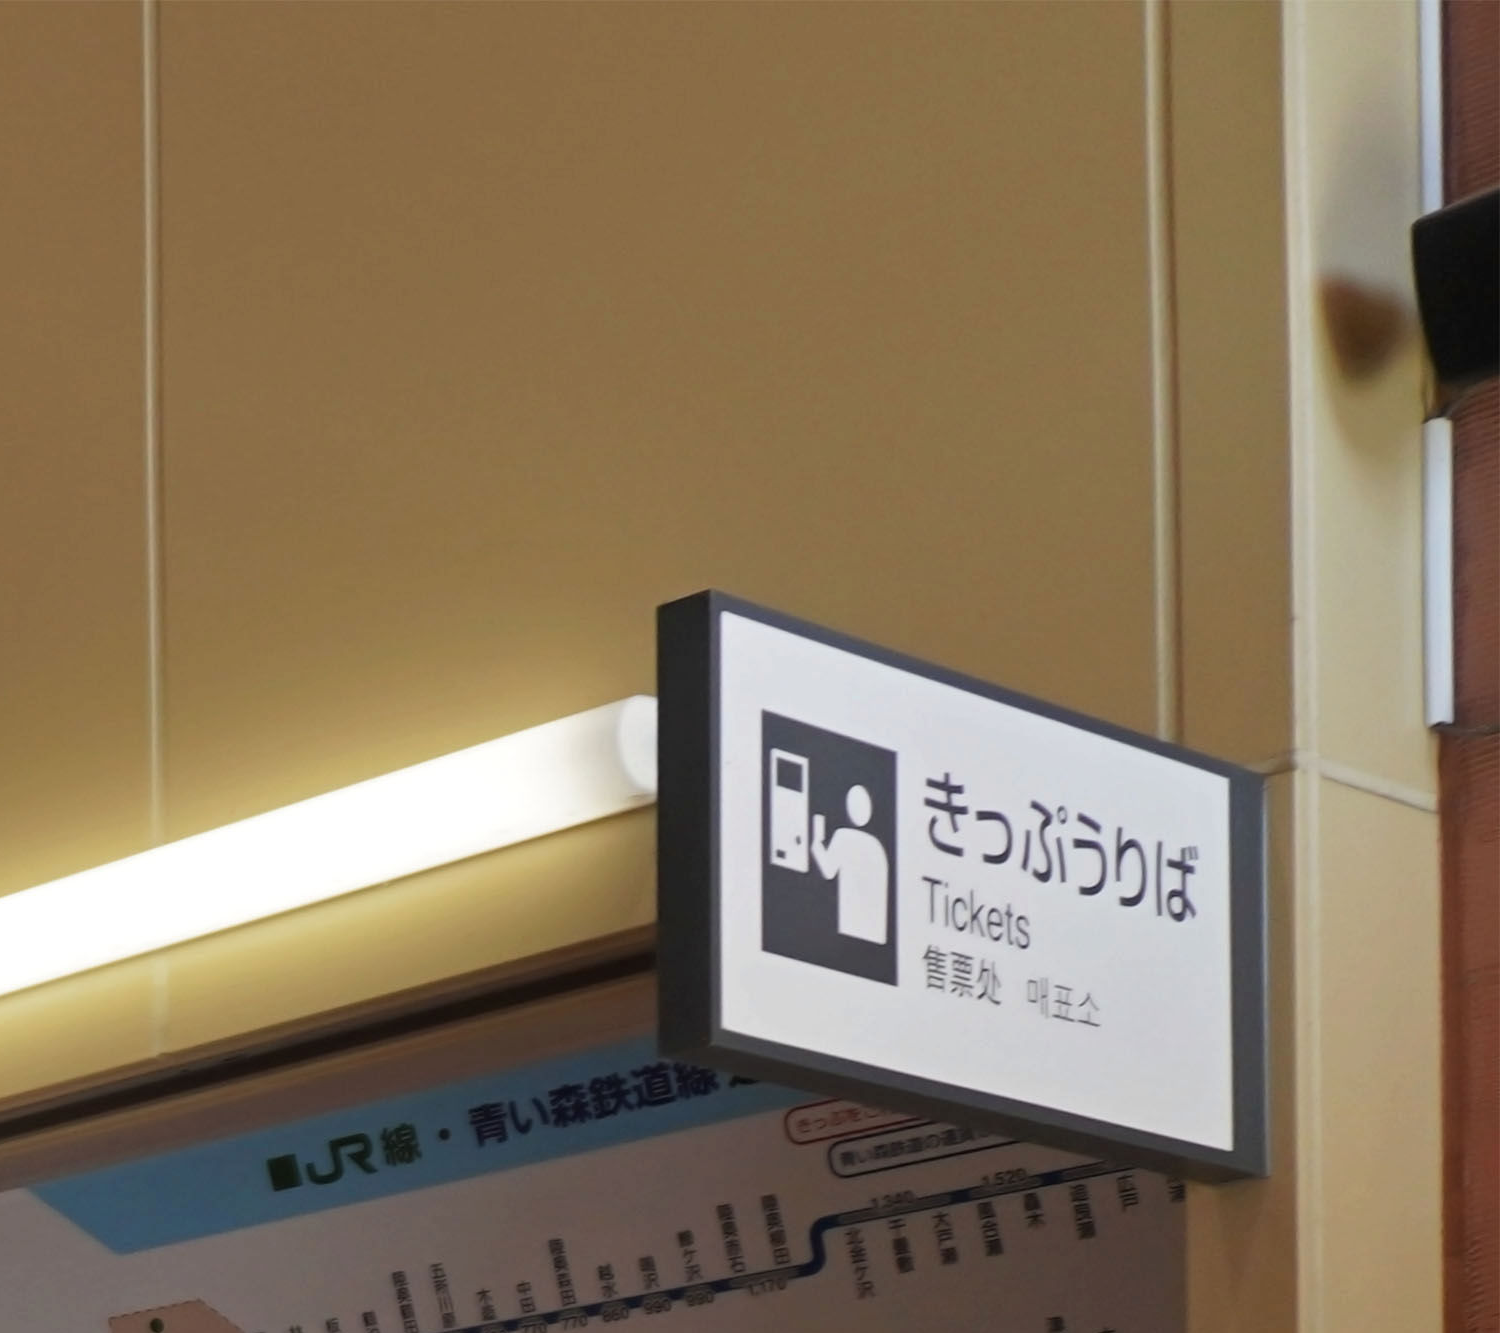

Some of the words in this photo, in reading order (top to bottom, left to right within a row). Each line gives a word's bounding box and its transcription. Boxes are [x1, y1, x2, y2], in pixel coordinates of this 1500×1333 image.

[923, 772, 1199, 923] きっぷうりば
[922, 876, 1030, 950] Tickets
[923, 944, 1002, 1006] 售票处
[1026, 977, 1101, 1028] 매표소
[517, 1281, 536, 1313] 中田
[562, 1313, 588, 1329] 770
